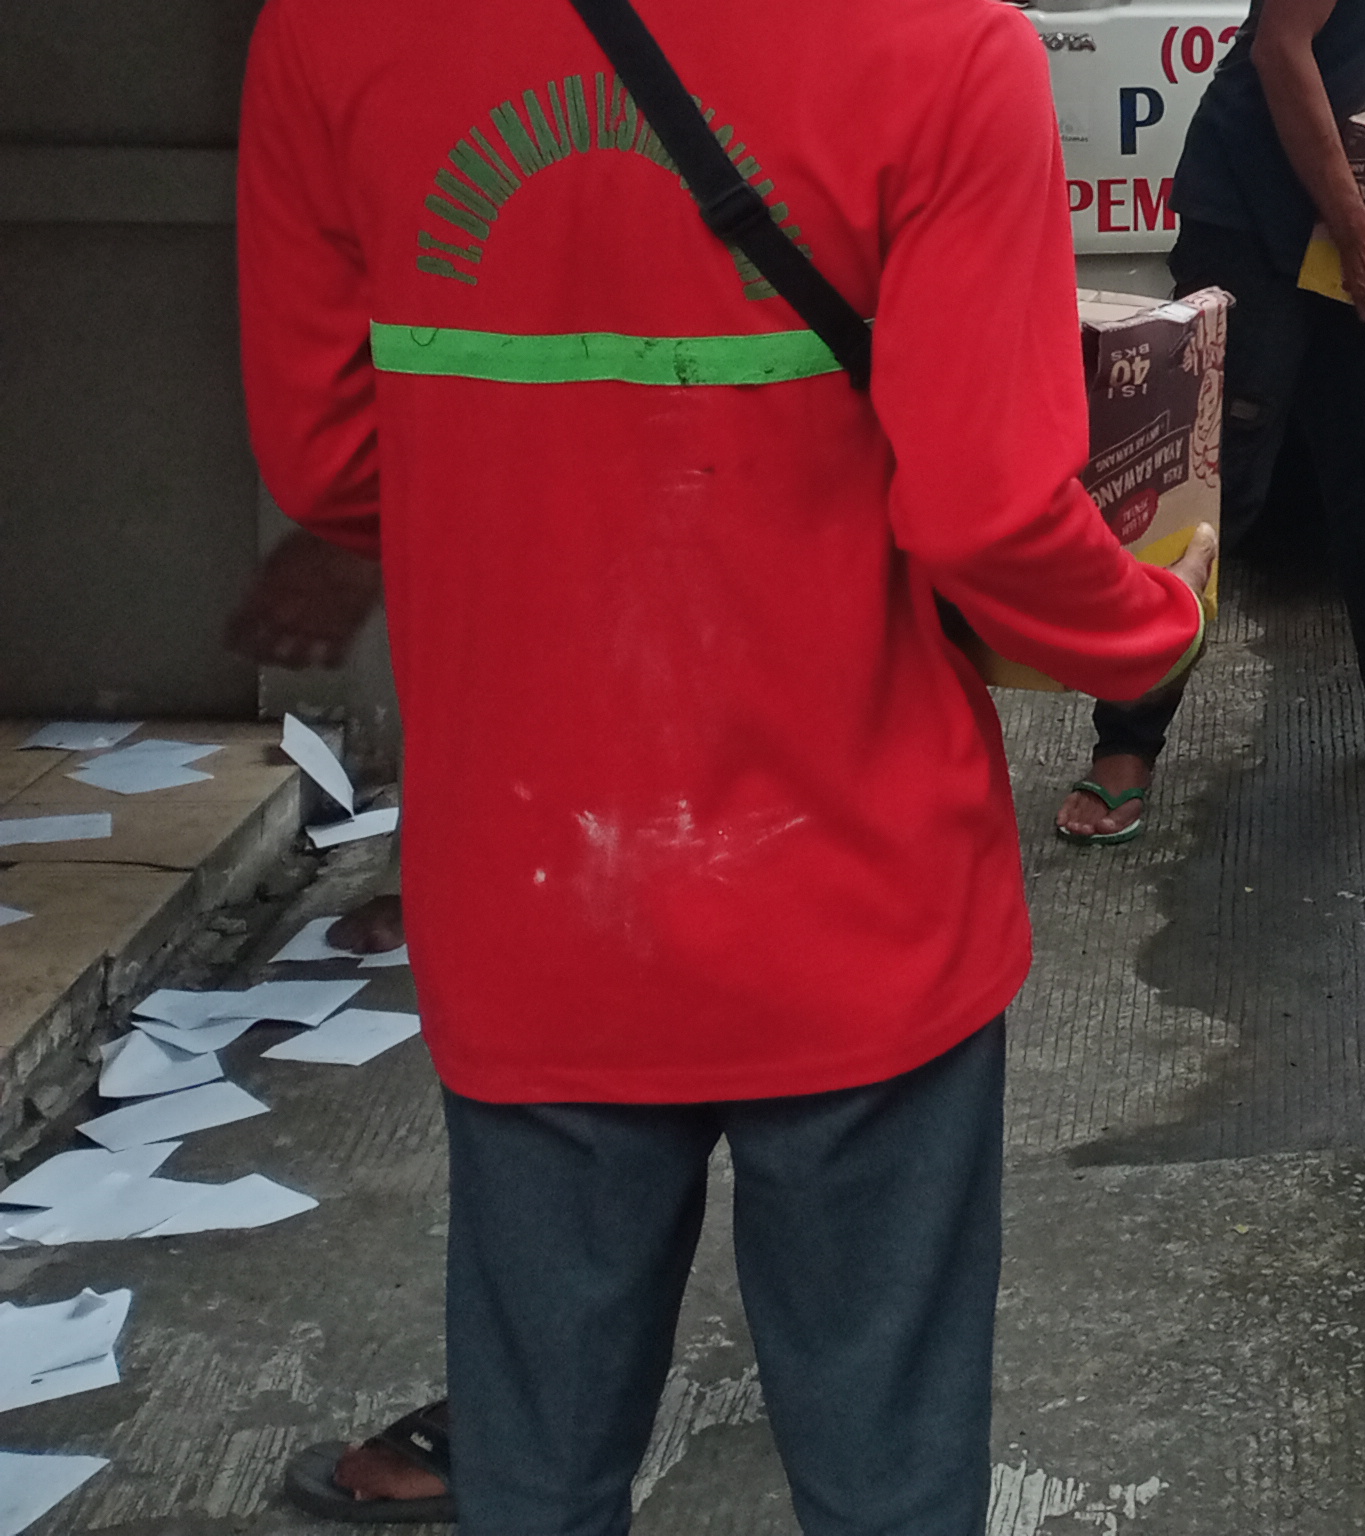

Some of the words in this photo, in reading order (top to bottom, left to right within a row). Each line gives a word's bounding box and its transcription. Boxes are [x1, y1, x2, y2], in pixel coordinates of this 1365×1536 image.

[1110, 342, 1150, 361] BKS
[1110, 355, 1150, 386] 40
[1107, 382, 1148, 399] ISI
